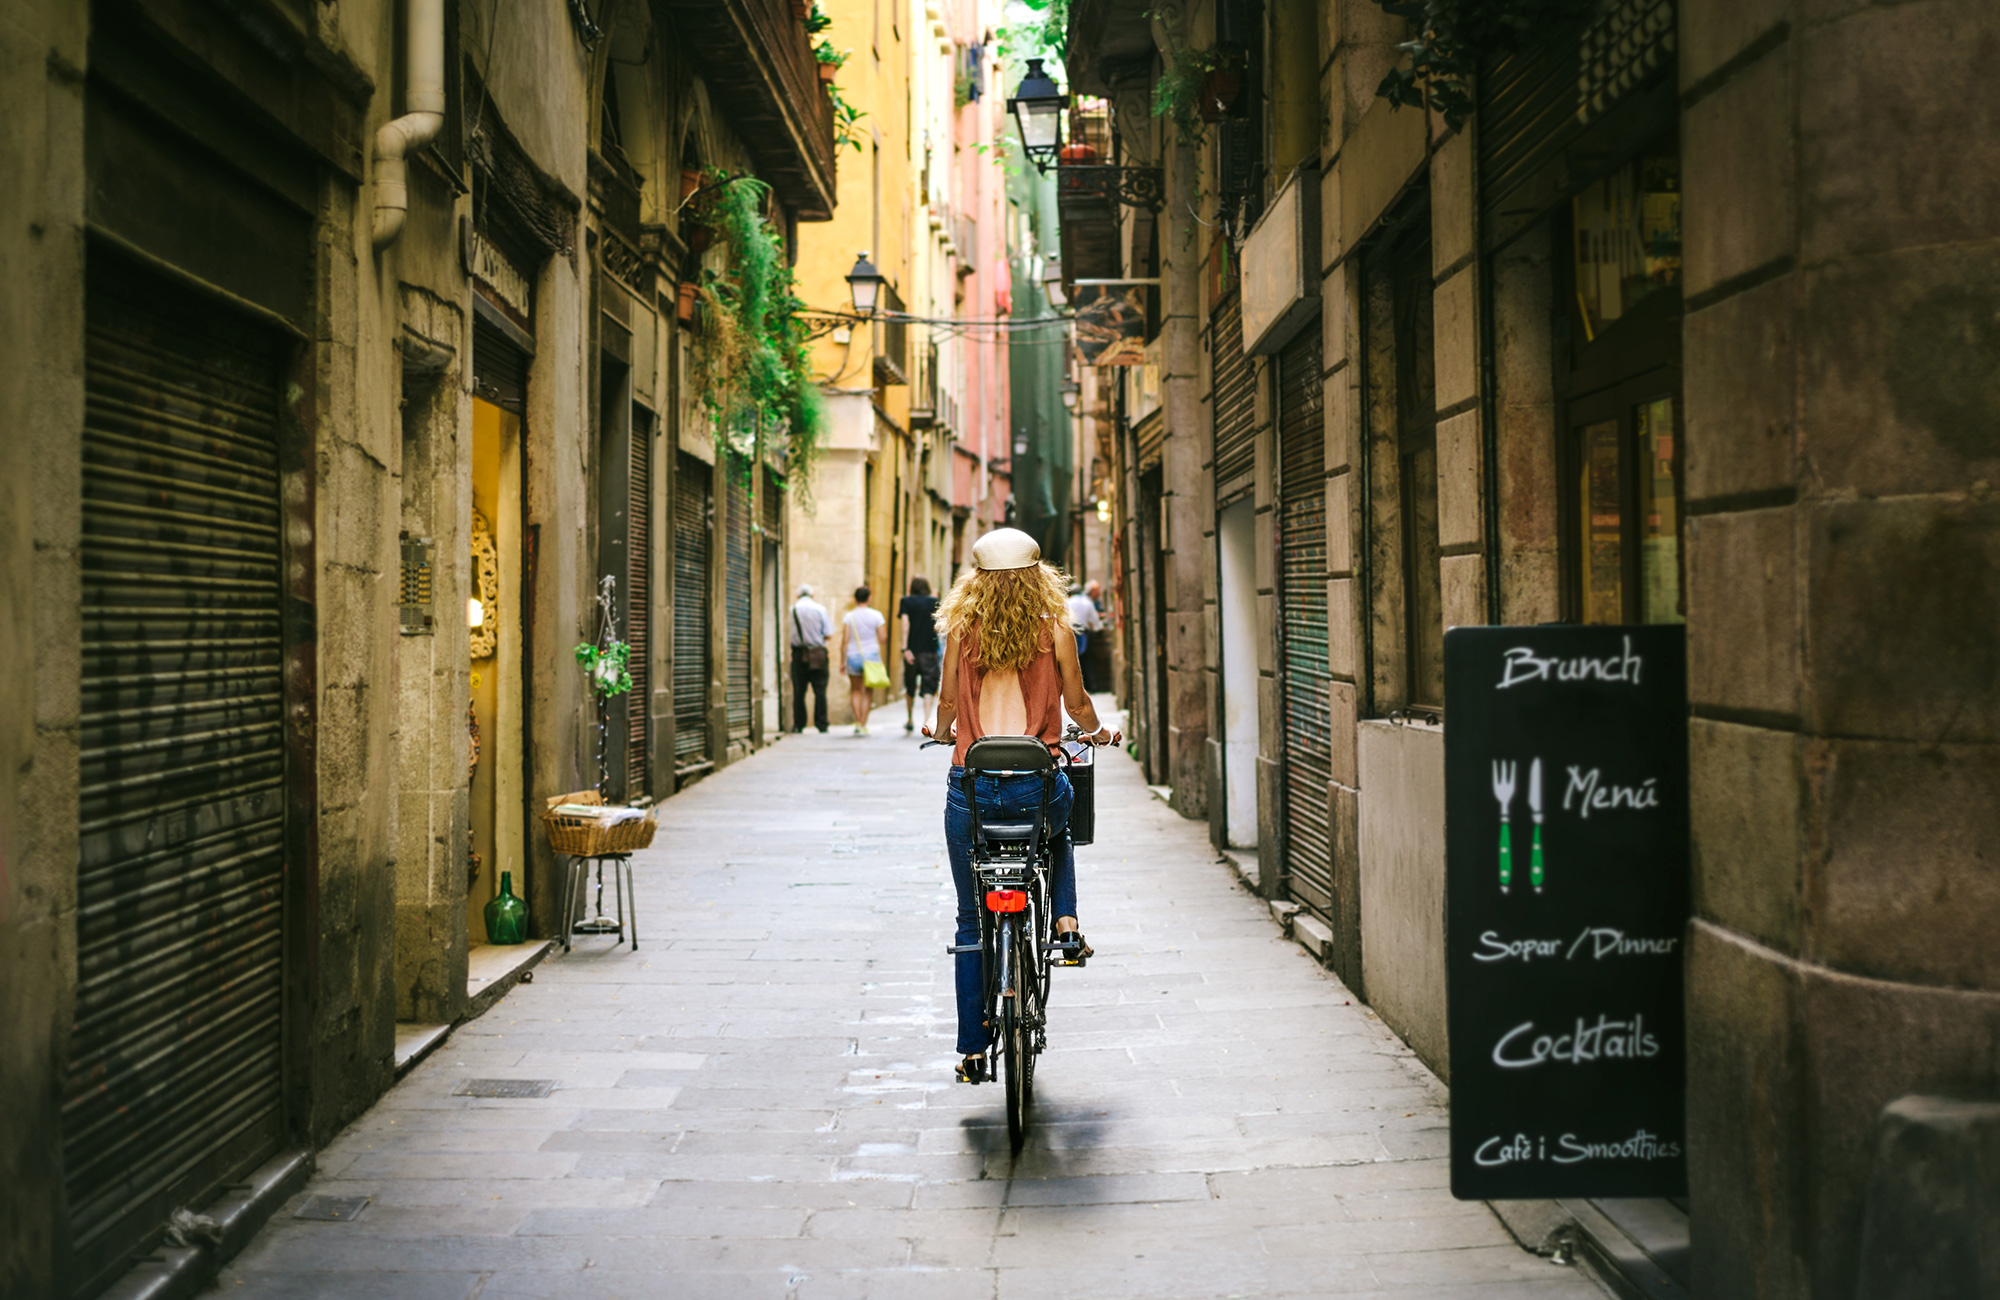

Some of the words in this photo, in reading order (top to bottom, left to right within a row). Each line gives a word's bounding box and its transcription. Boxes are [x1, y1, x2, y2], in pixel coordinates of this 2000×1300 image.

[1495, 635, 1642, 690] Brunch
[1562, 765, 1659, 819] Menú
[1471, 929, 1563, 962] Sopar
[1491, 1013, 1660, 1068] Cocktails
[1538, 1135, 1546, 1160] i
[1550, 1129, 1681, 1164] Smoothies
